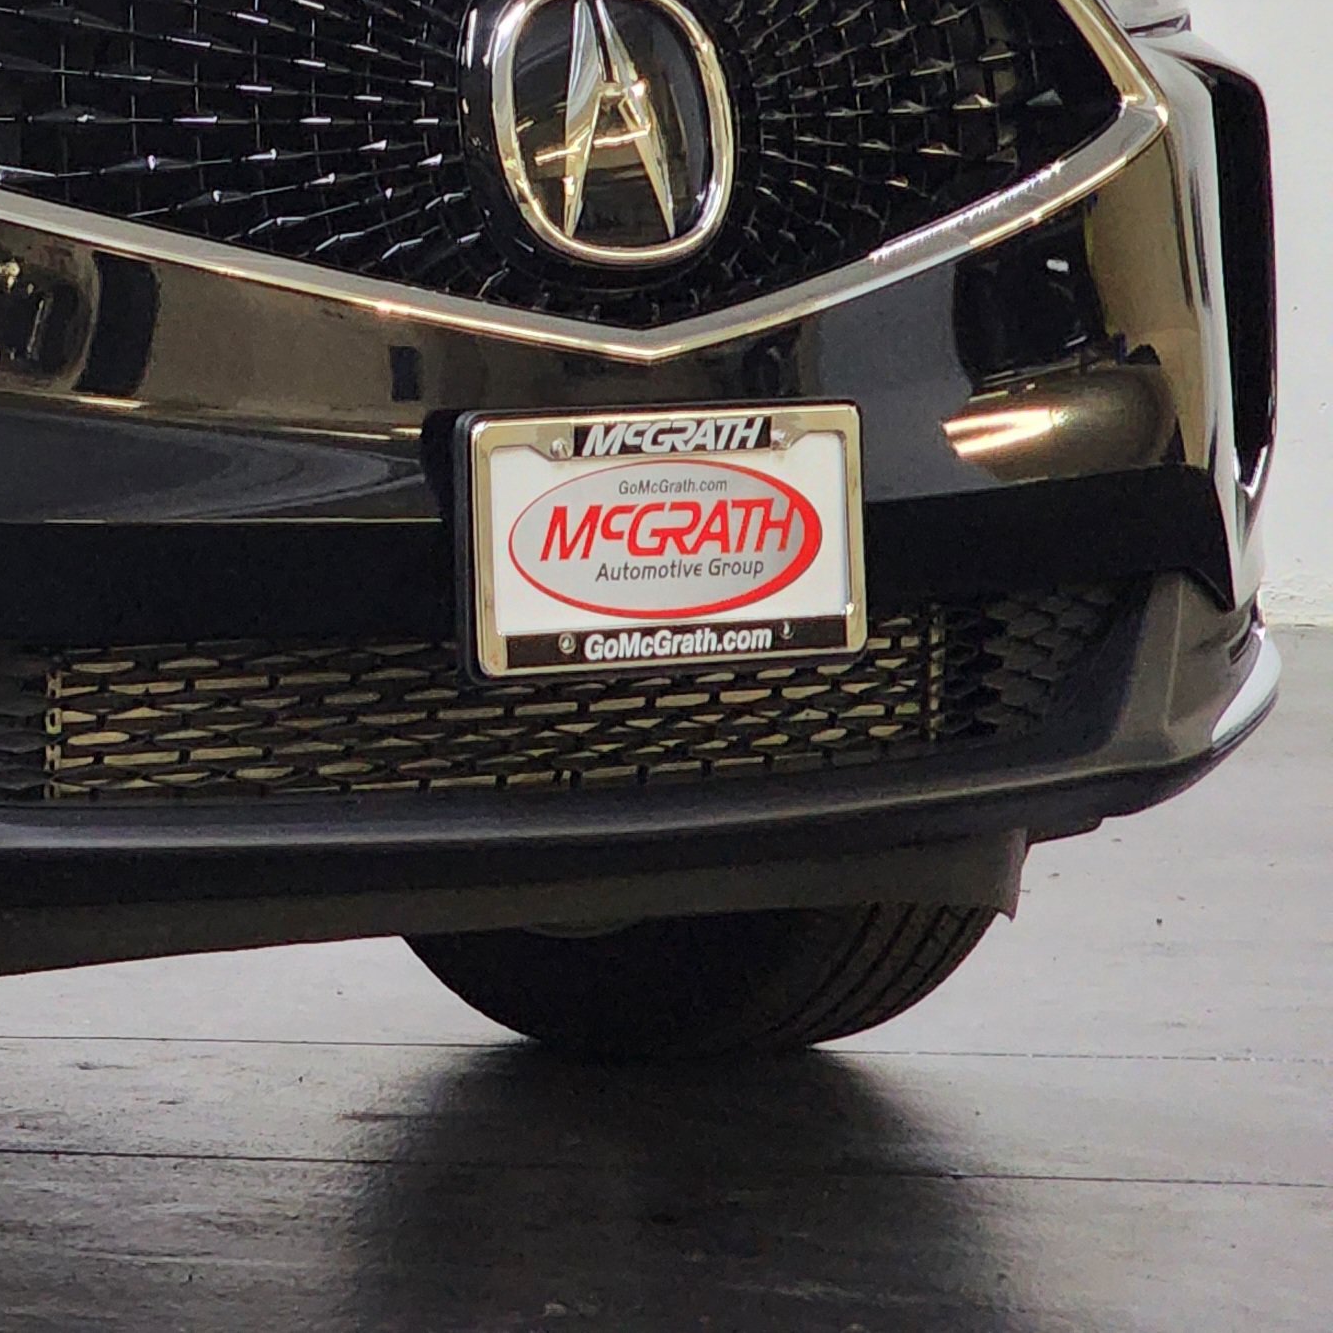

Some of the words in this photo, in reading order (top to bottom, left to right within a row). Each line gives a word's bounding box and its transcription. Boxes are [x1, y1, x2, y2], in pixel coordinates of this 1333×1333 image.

[618, 479, 727, 495] GoMcGrath.com
[595, 560, 703, 582] Automotive
[708, 559, 764, 580] Group
[584, 627, 772, 661] GoMcGrath.com
